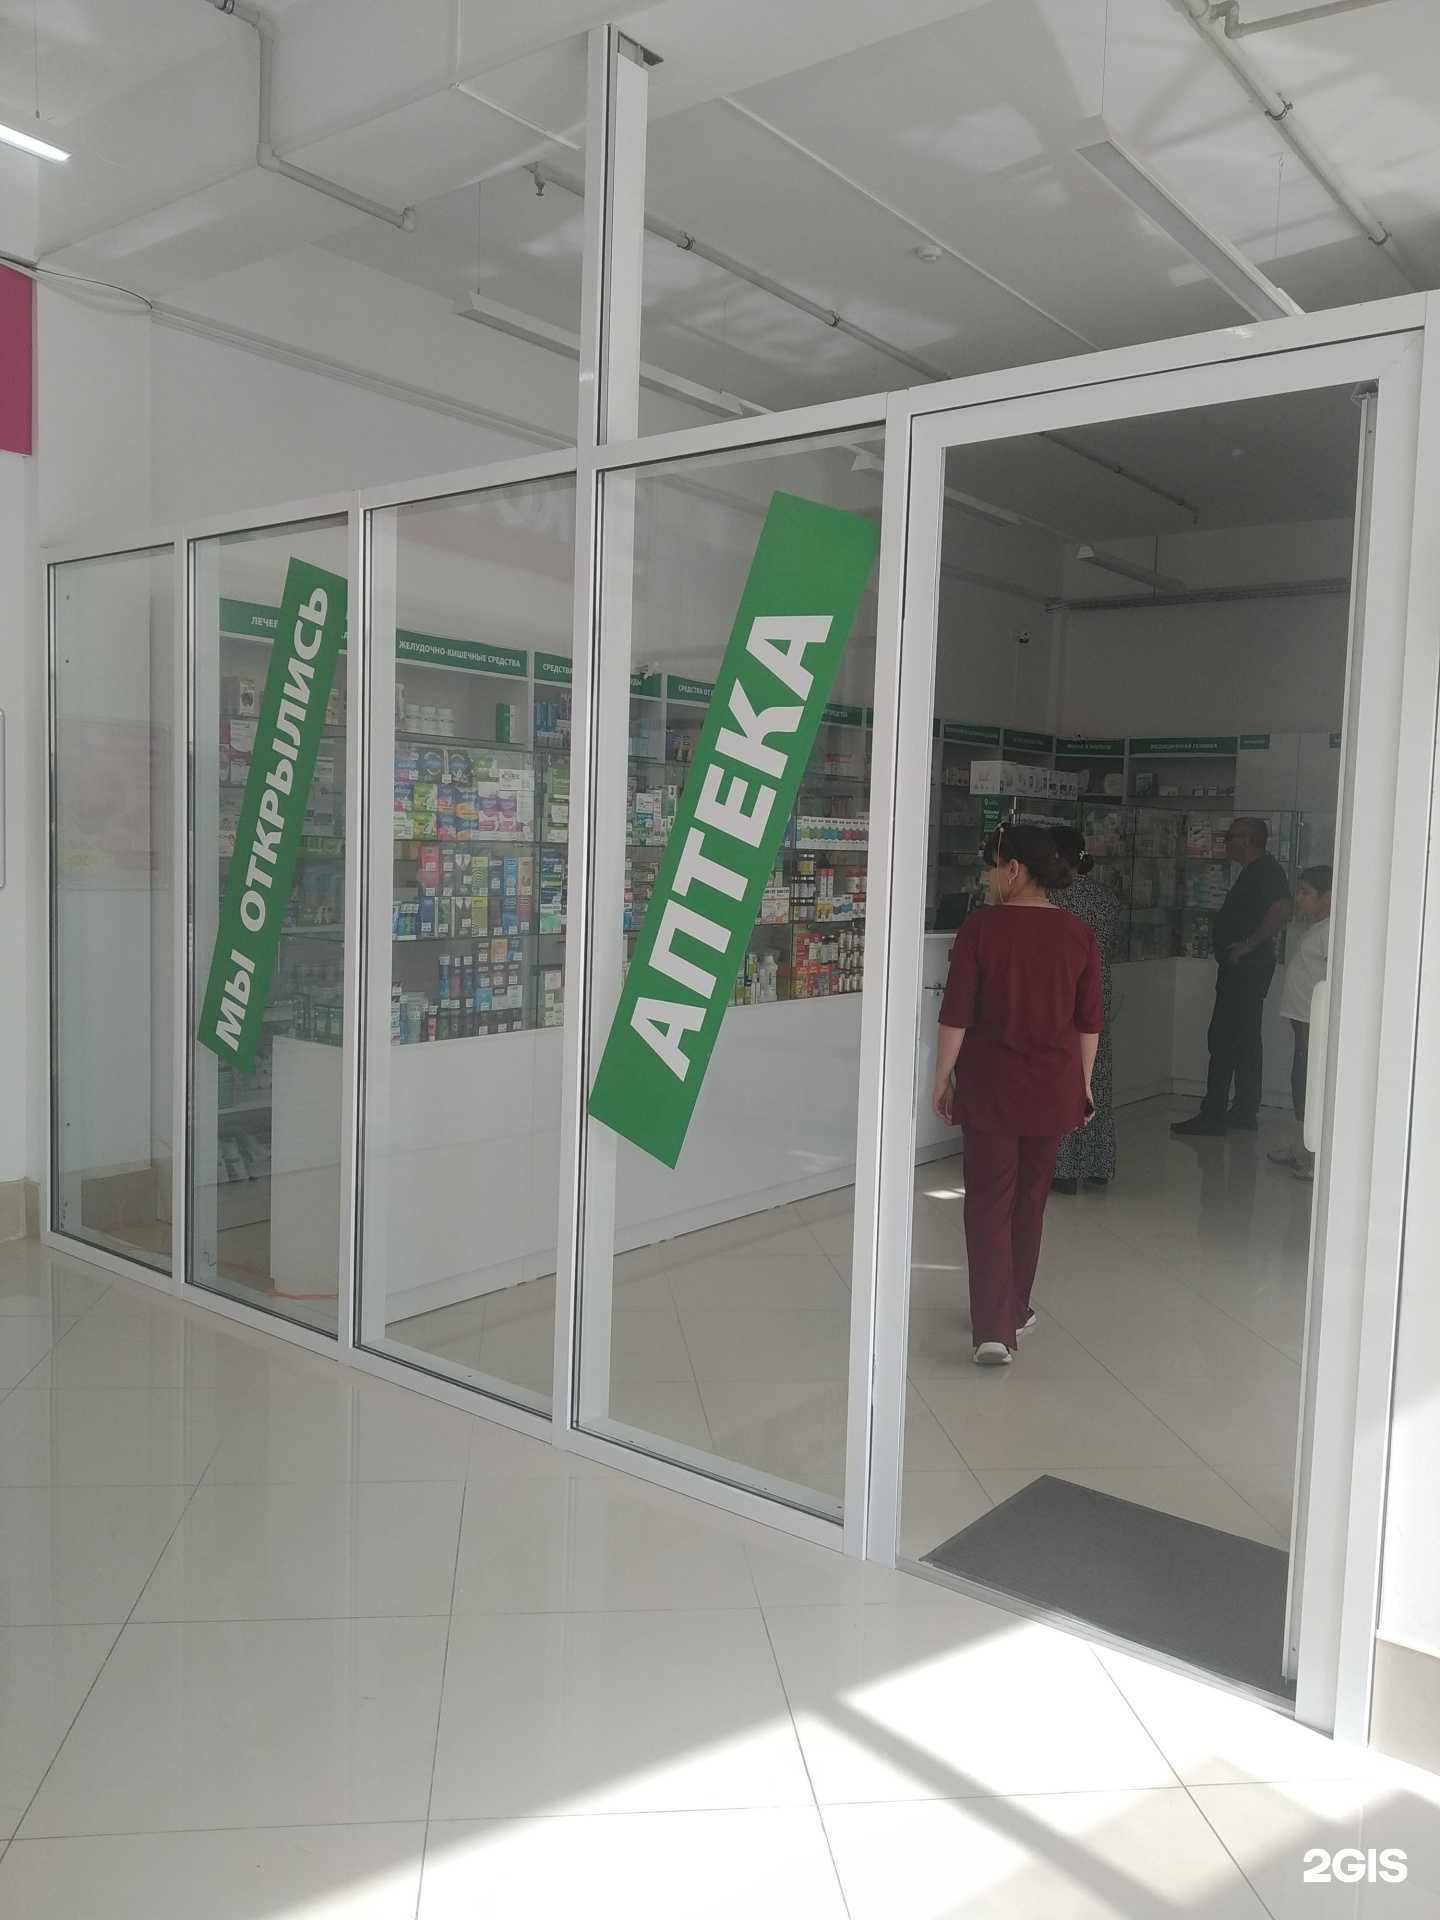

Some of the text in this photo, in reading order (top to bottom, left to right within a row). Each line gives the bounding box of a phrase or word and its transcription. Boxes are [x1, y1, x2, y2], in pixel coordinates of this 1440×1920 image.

[215, 587, 329, 1051] МЫ ОТКРЫЛИСЬ
[399, 640, 521, 668] ЖЕЛУДОЧНО-КИШЕЧНЫЕ СРЕДСТВА
[629, 614, 834, 1082] АПТЕКА
